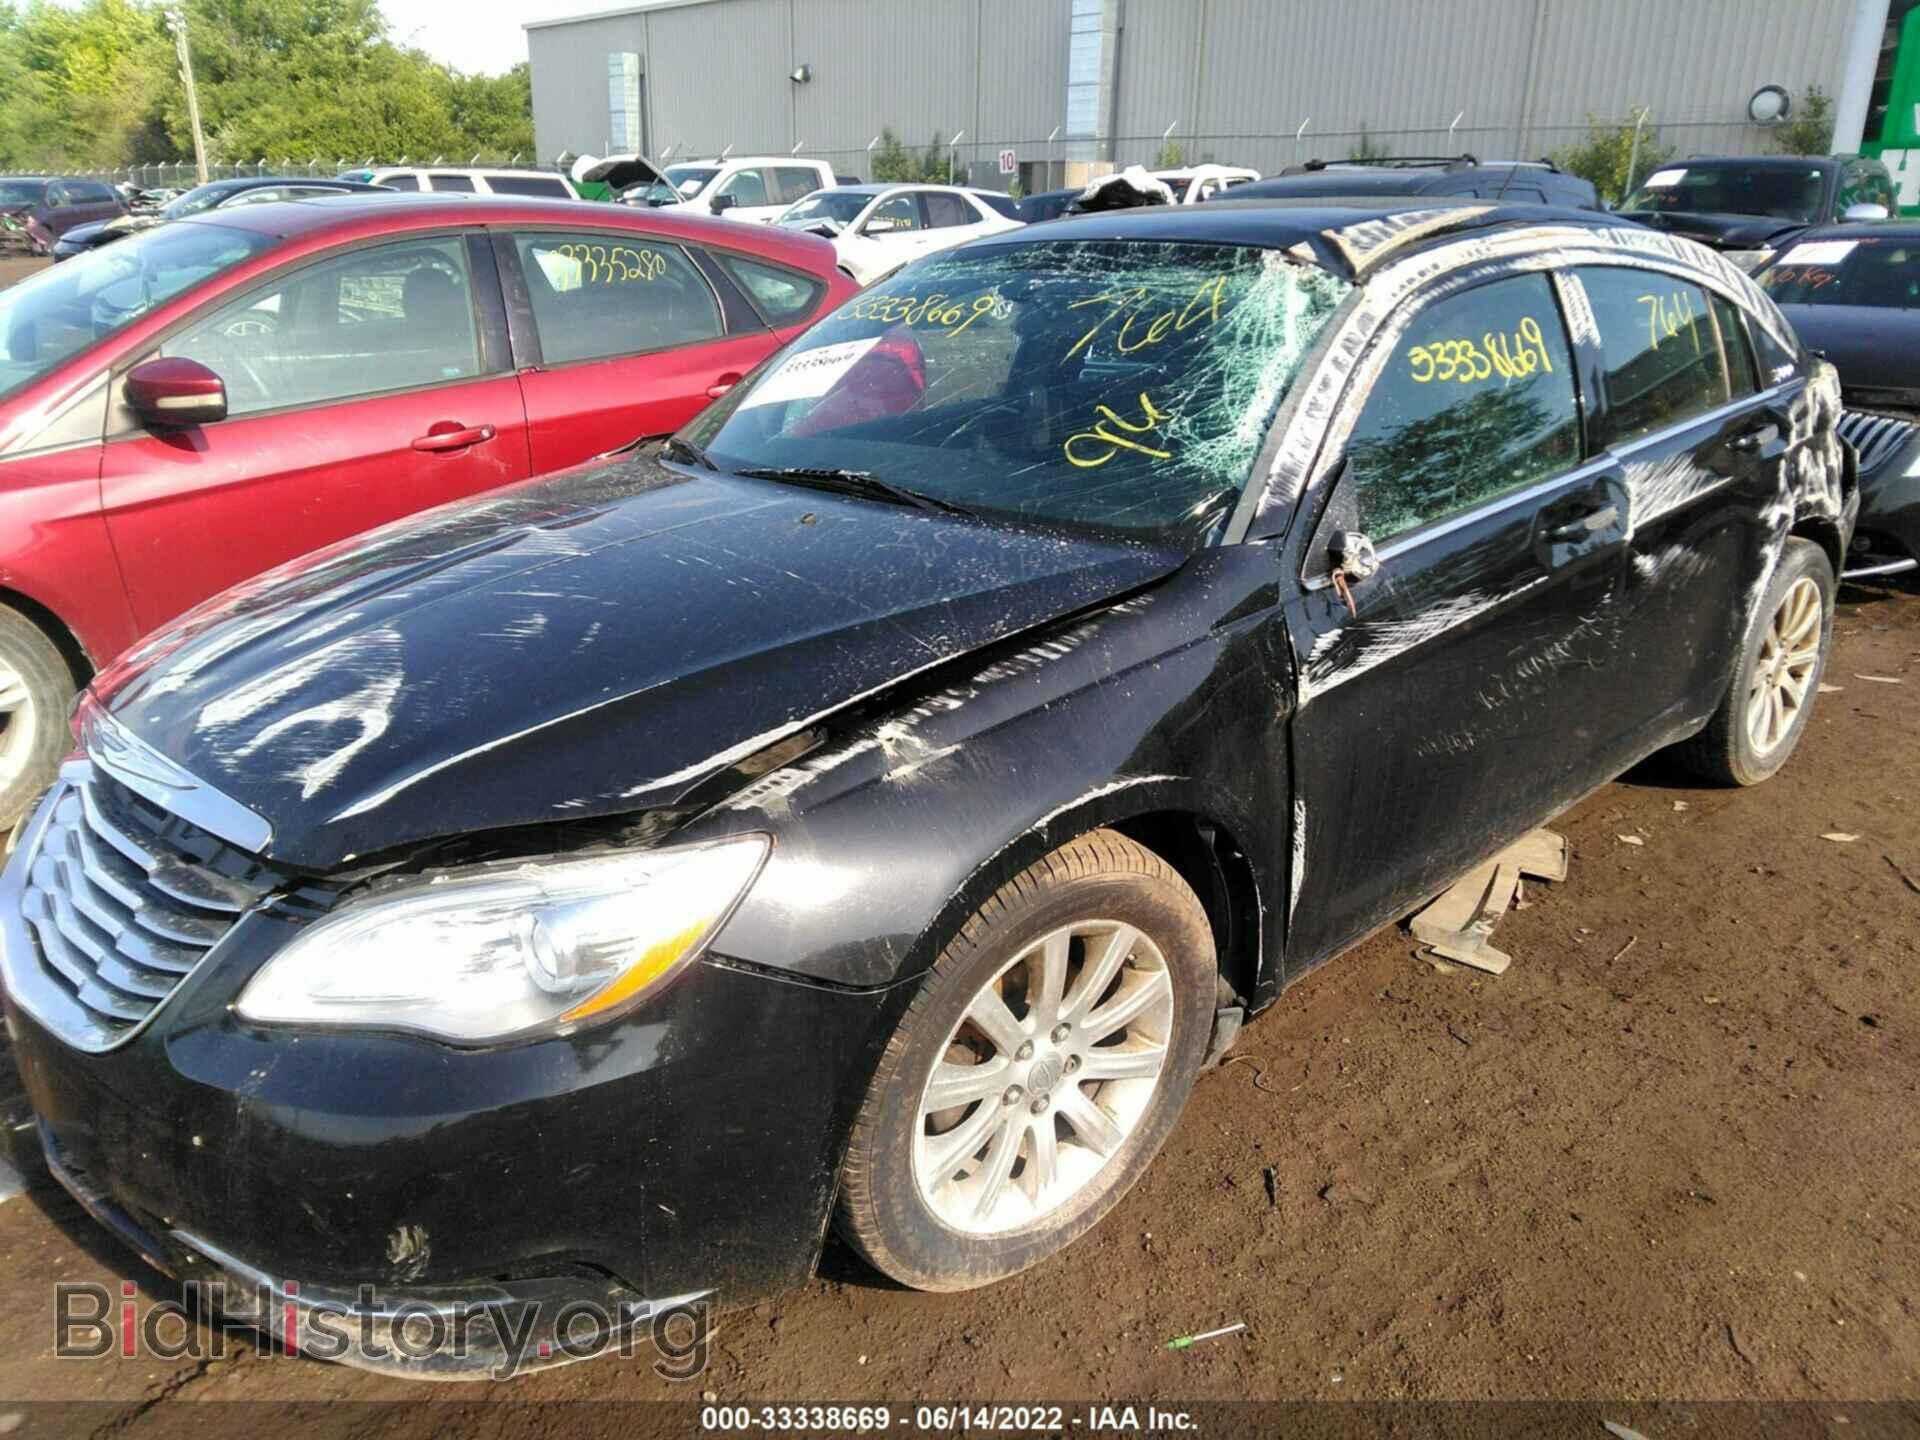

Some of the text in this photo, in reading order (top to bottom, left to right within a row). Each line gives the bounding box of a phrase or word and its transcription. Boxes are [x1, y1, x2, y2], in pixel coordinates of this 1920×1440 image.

[1001, 153, 1014, 170] 10
[1408, 317, 1552, 383] 33338669
[1637, 291, 1700, 352] 764
